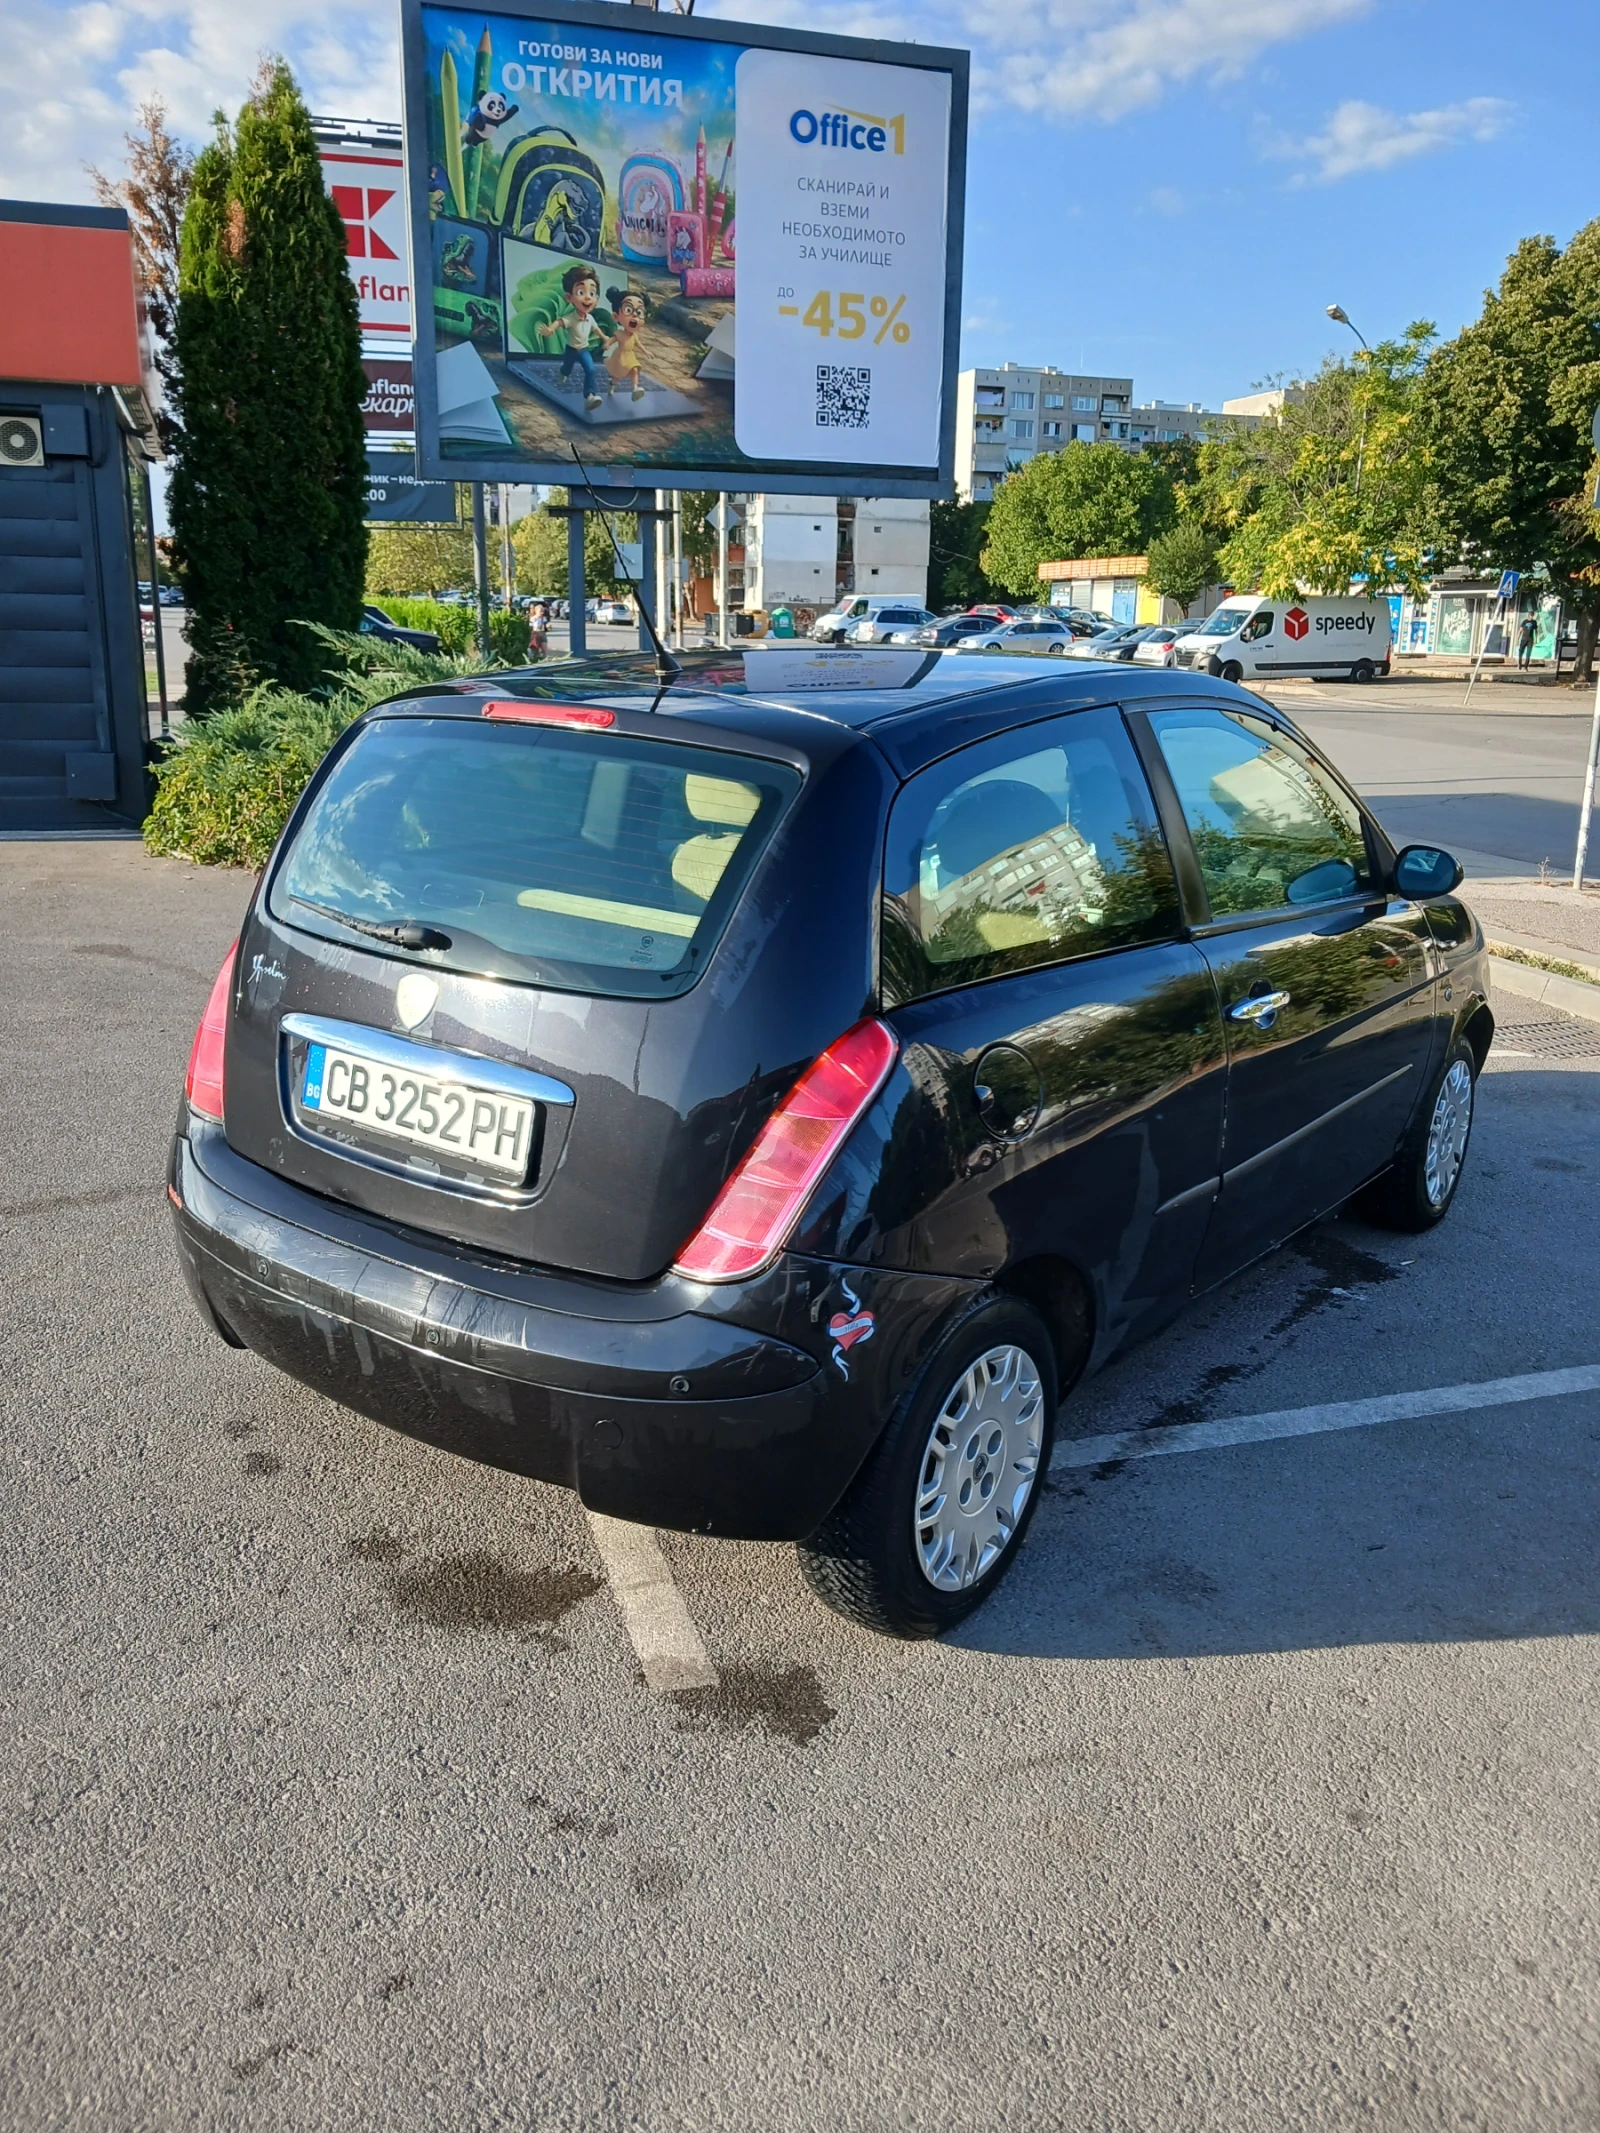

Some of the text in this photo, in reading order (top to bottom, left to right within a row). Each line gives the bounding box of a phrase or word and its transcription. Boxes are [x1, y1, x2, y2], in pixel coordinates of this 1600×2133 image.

[518, 40, 663, 70] ГОТОВИ ЗА НОВИ
[501, 62, 683, 107] ОТКРИТИЯ
[797, 177, 890, 200] СКАНИРАЙ И
[820, 202, 870, 220] ВЗЕМИ
[782, 221, 906, 246] НЕОБХОДИМОТО
[799, 245, 893, 268] ЗА УЧИЛИЩЕ
[358, 275, 410, 303] flan
[778, 290, 911, 346] -45%
[367, 378, 414, 395] uflan
[1315, 611, 1376, 635] speedy
[306, 1082, 321, 1100] BG
[327, 1059, 526, 1161] CB 3252 PH
